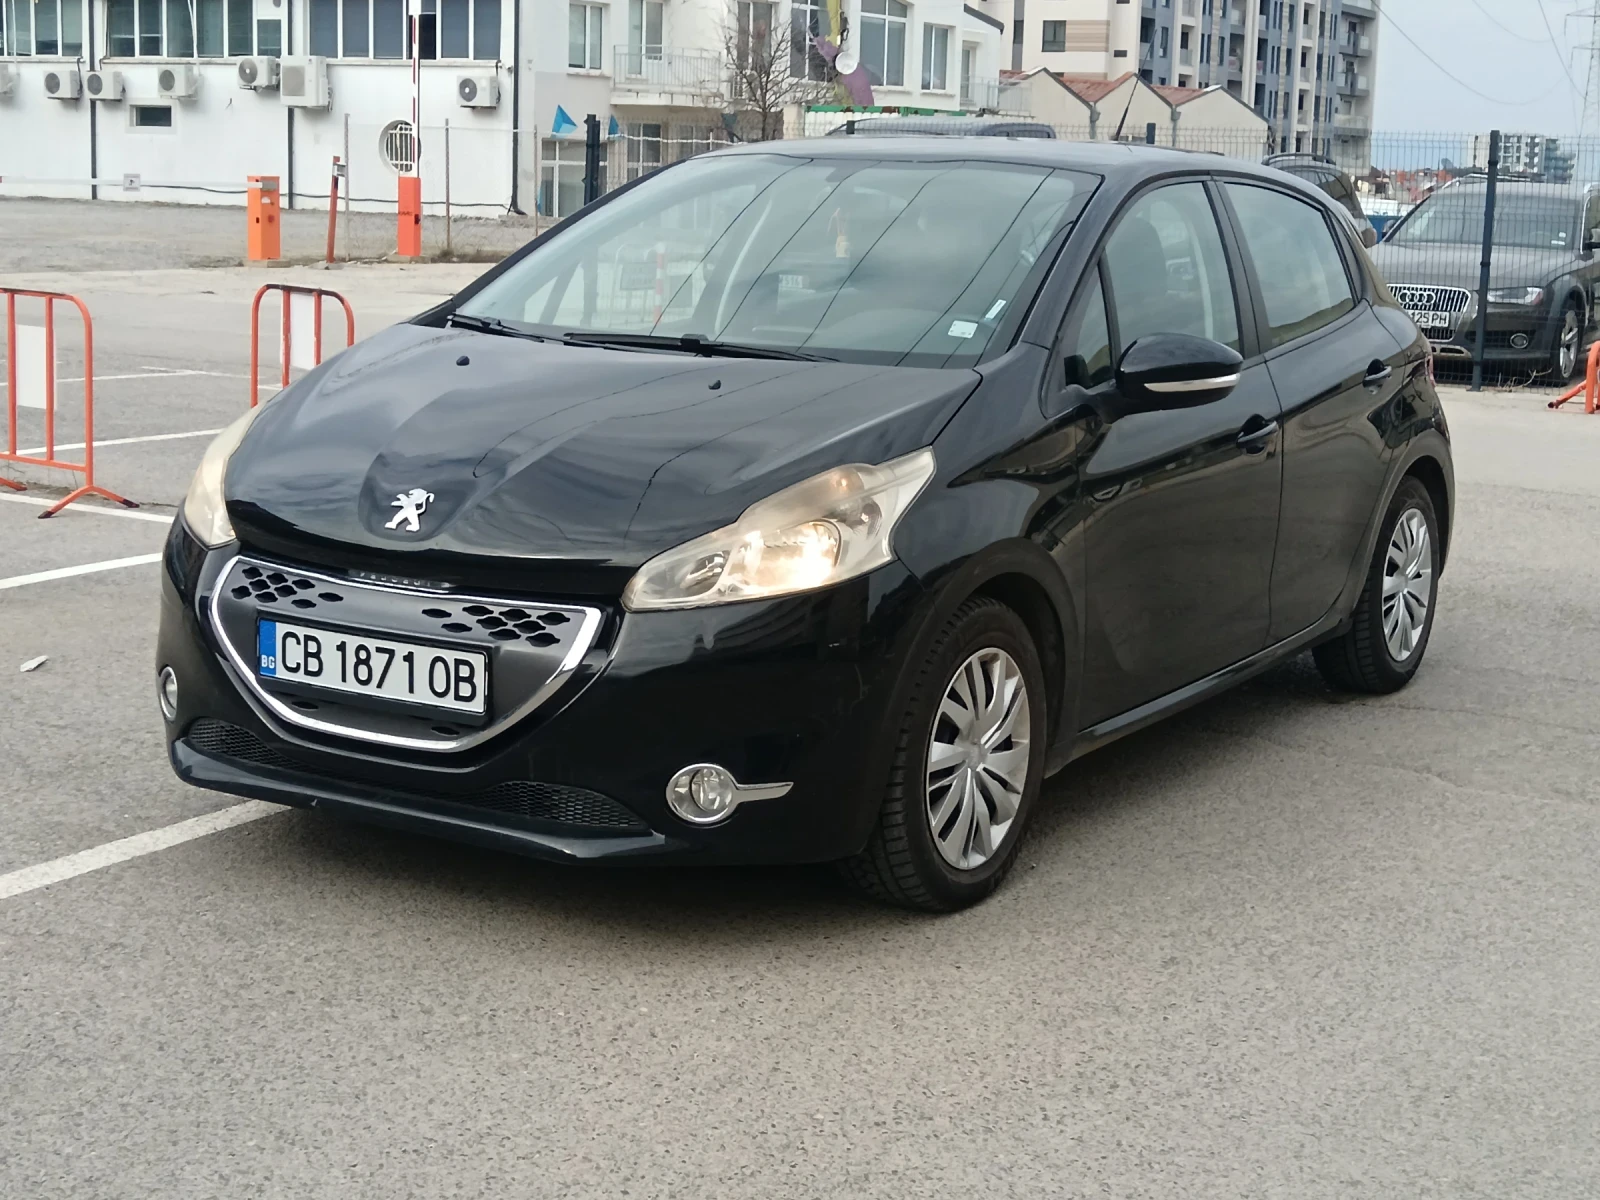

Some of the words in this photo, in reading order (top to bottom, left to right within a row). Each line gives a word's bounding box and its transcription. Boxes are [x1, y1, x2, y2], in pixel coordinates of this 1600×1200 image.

[1431, 313, 1448, 325] PH
[261, 654, 275, 669] BG
[281, 631, 324, 678] CB
[336, 640, 415, 694] 1871
